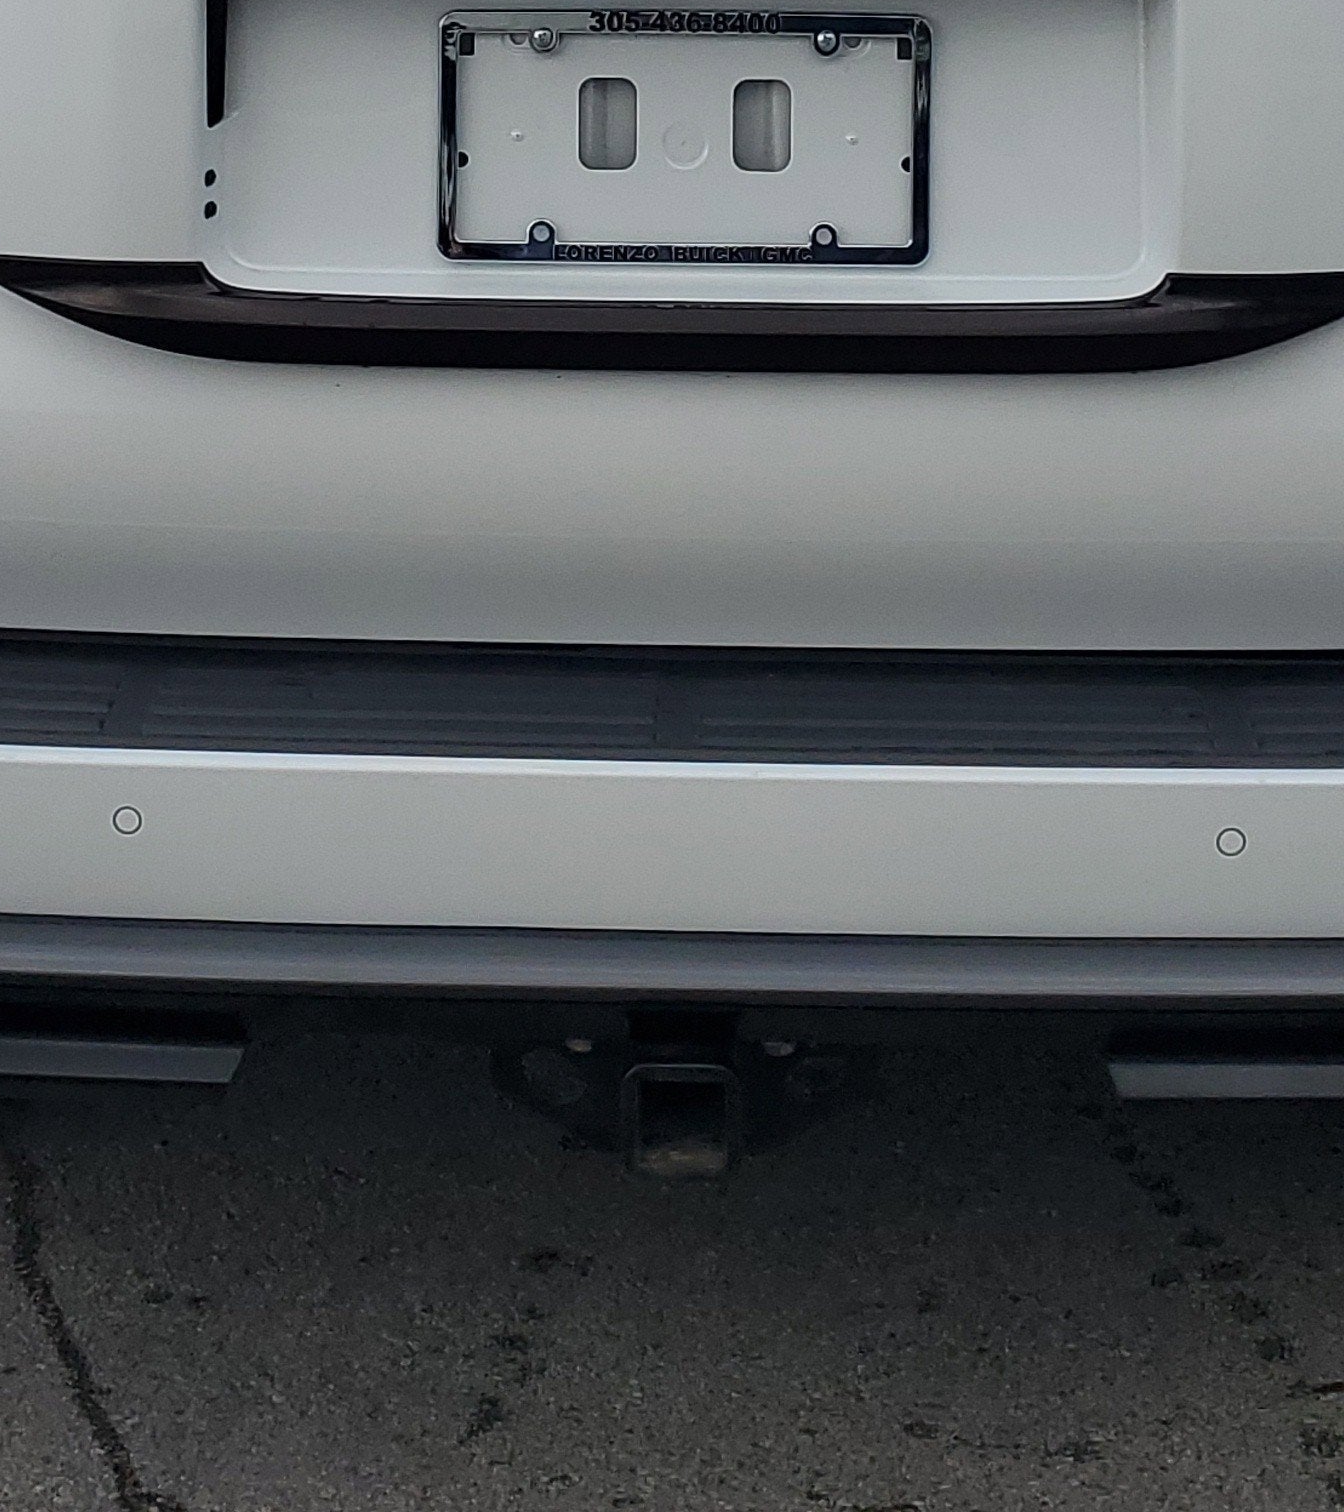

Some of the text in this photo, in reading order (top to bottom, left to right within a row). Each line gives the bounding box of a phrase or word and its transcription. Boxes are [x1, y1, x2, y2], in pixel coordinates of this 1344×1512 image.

[589, 10, 781, 34] 305-436-8400
[554, 244, 813, 264] LORENZO BUICK GMC
